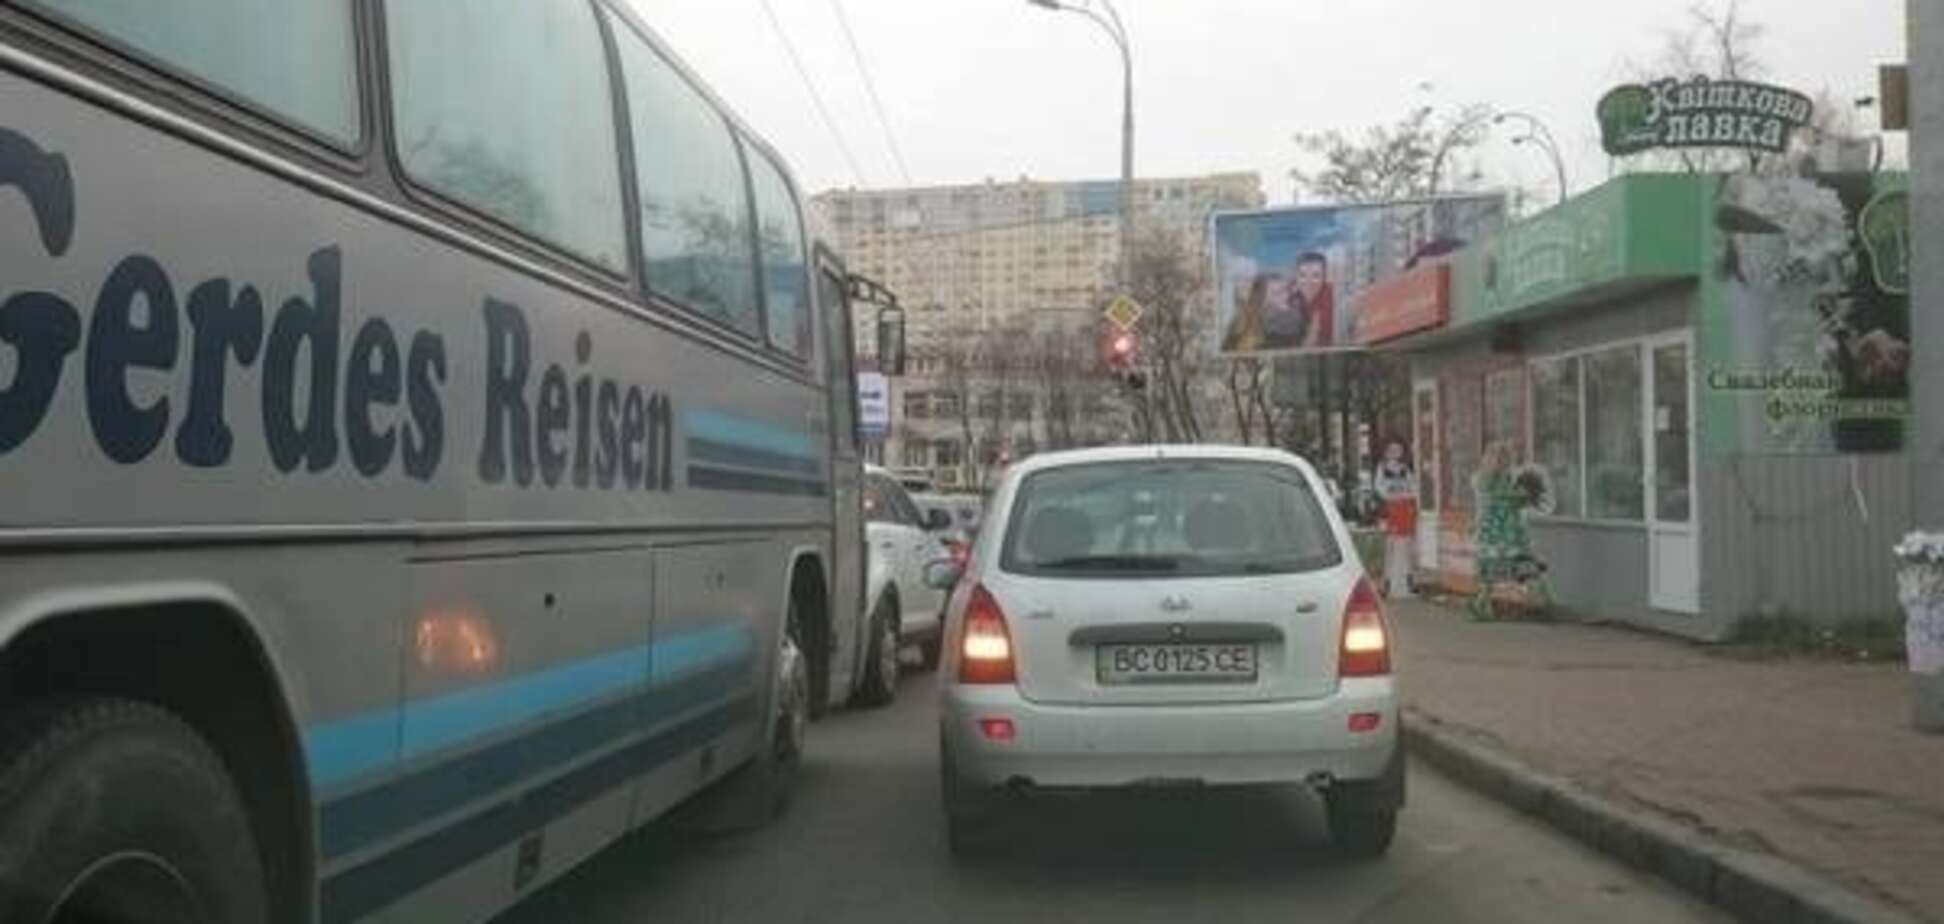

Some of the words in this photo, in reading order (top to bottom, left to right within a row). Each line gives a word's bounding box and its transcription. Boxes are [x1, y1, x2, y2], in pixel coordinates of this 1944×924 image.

[1645, 80, 1809, 124] Квіткова
[1664, 111, 1781, 145] лавка
[478, 295, 673, 492] Reisen
[1113, 649, 1151, 673] BC
[1153, 648, 1211, 673] 0125
[1215, 647, 1250, 673] CE
